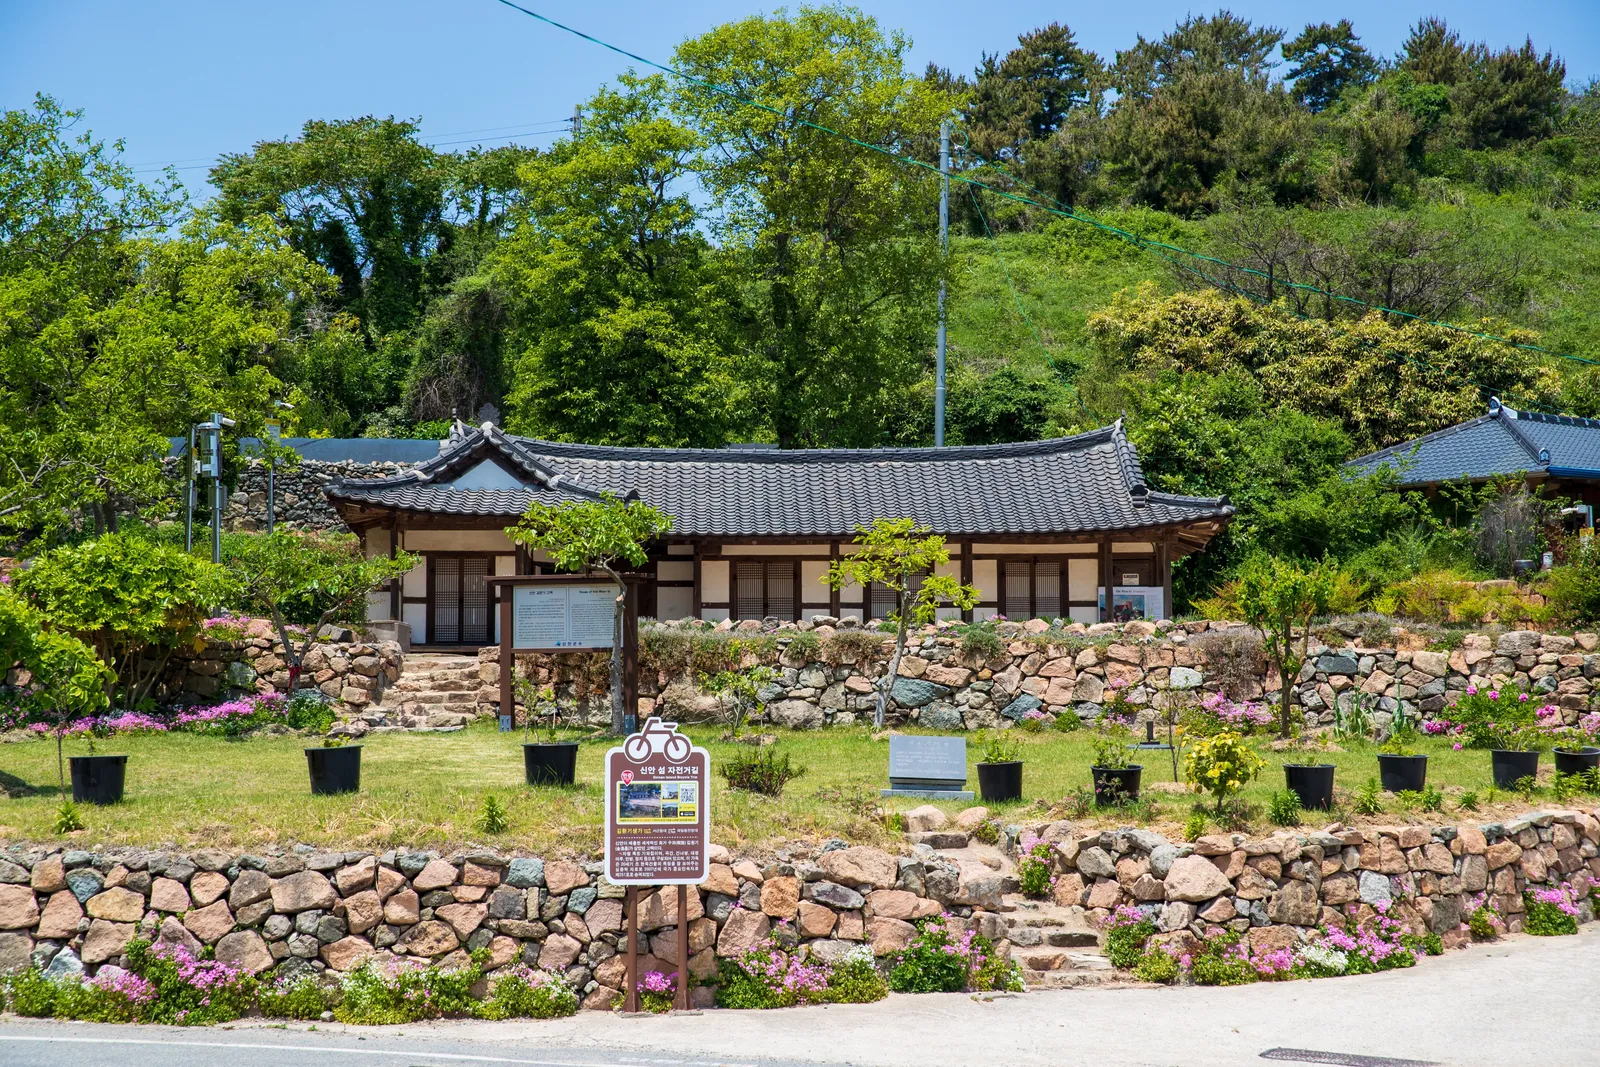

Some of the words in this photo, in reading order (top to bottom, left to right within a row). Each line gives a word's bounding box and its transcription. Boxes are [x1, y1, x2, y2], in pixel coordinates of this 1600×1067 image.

[640, 766, 655, 774] 신안
[658, 766, 665, 774] 섬
[668, 766, 699, 774] 자전거길
